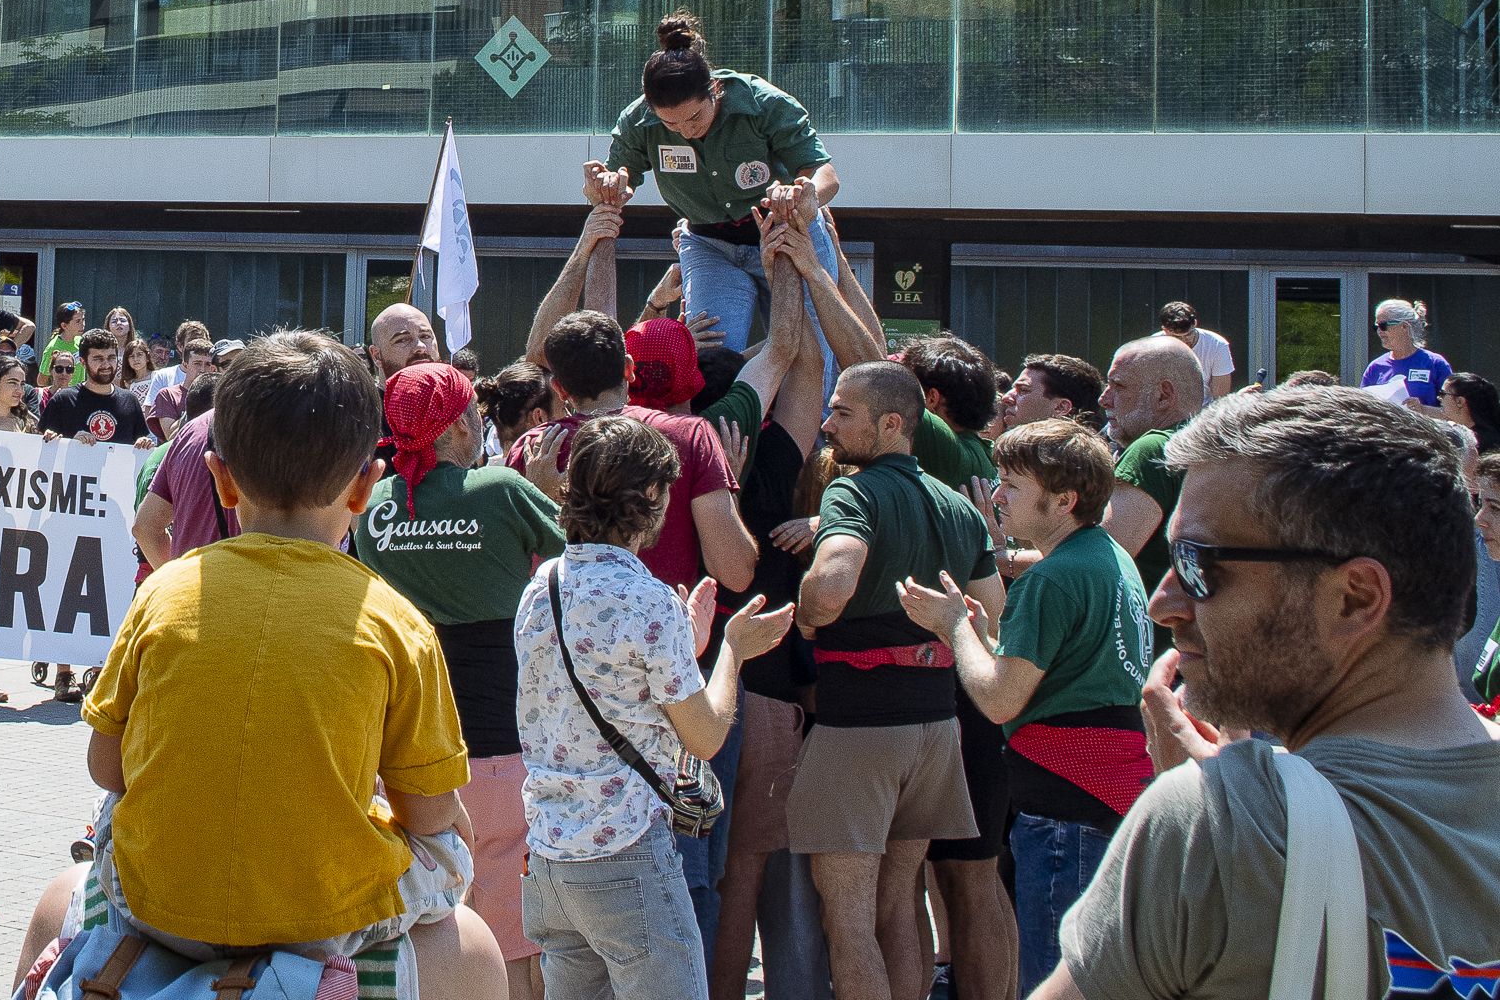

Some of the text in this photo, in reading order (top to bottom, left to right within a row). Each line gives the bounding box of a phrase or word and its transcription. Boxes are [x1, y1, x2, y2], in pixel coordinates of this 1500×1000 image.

[895, 293, 921, 302] DEA
[368, 500, 479, 551] Gausacs
[425, 541, 435, 550] de
[436, 541, 454, 550] Sant
[455, 541, 481, 551] Cugat
[1115, 639, 1127, 660] HO
